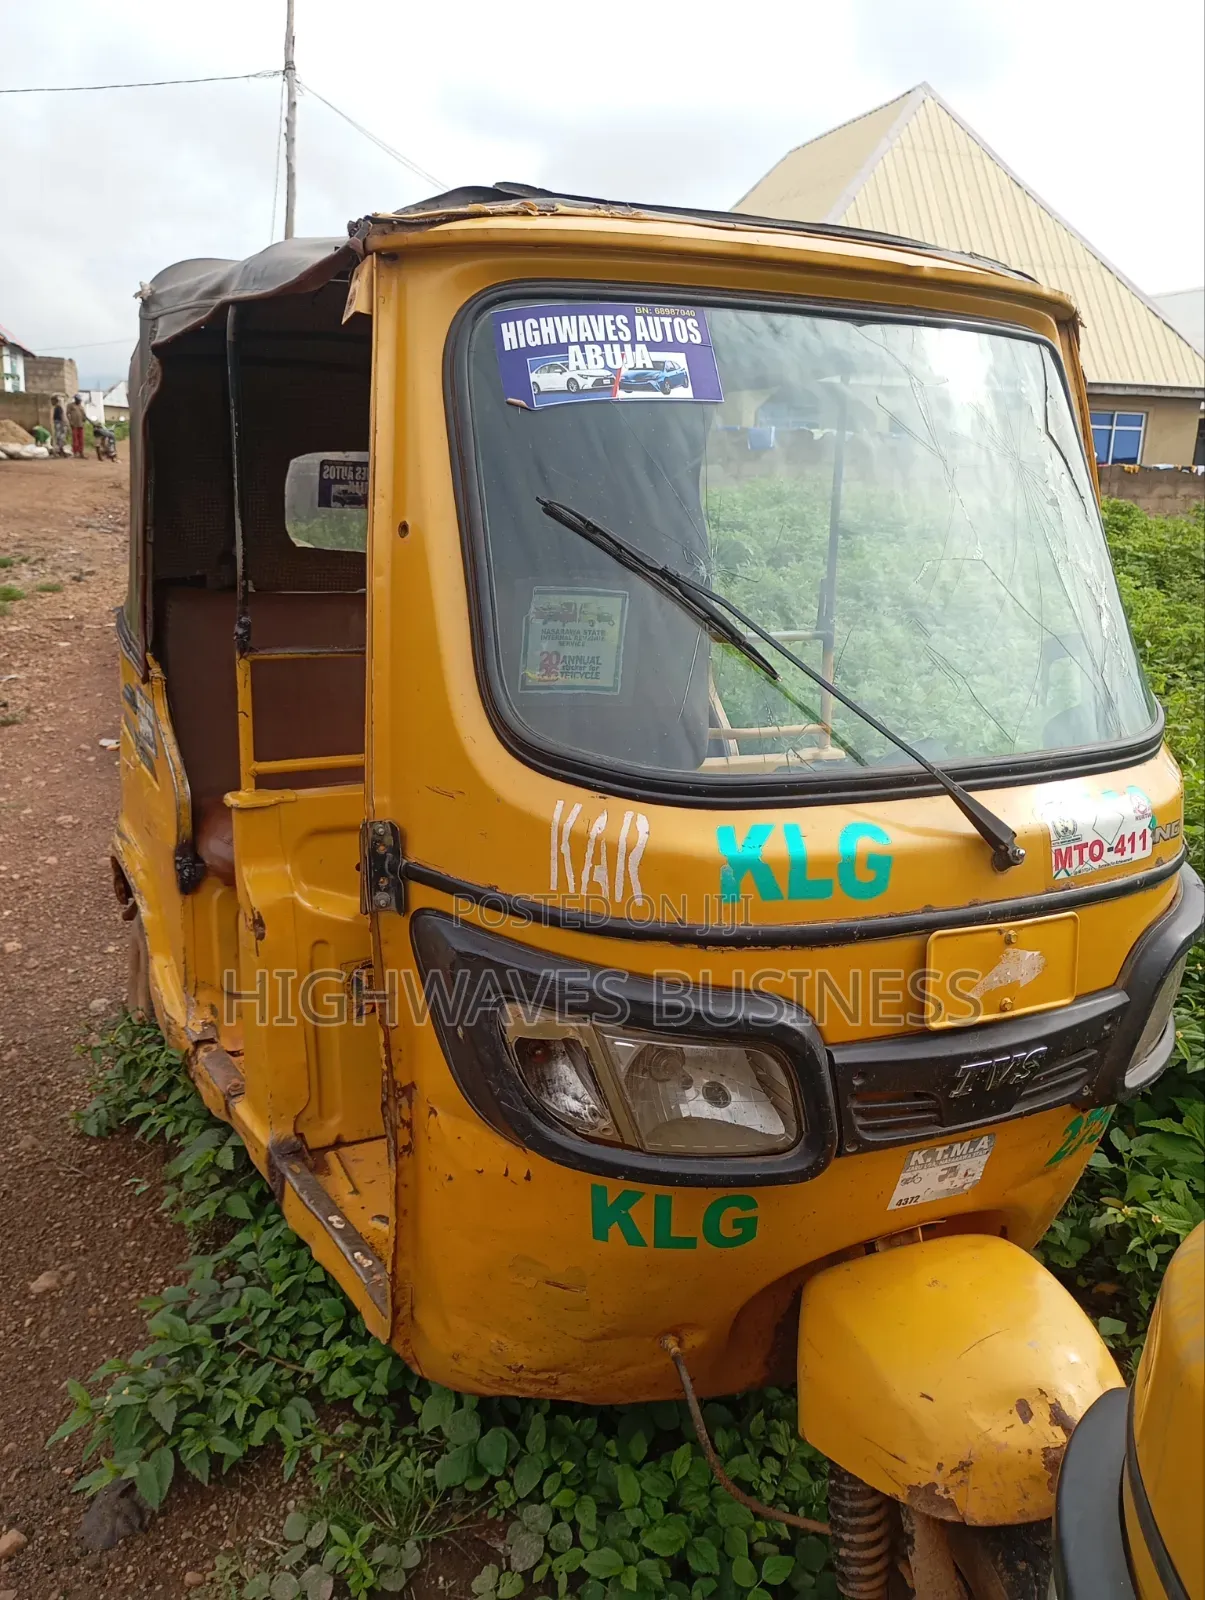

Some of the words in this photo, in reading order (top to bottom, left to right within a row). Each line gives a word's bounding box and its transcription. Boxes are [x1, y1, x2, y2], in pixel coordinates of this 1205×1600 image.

[634, 306, 652, 315] BN:
[654, 307, 696, 317] 68987040
[501, 314, 632, 351] HIGHWAVES
[635, 316, 702, 345] AUTOS
[568, 343, 654, 371] ABUJA
[561, 655, 603, 666] ANNUAL
[716, 822, 893, 903] KLG
[1054, 828, 1148, 872] MTO-411
[949, 1046, 1048, 1098] TVS
[591, 1184, 758, 1250] KLG
[895, 1194, 921, 1207] 4372
